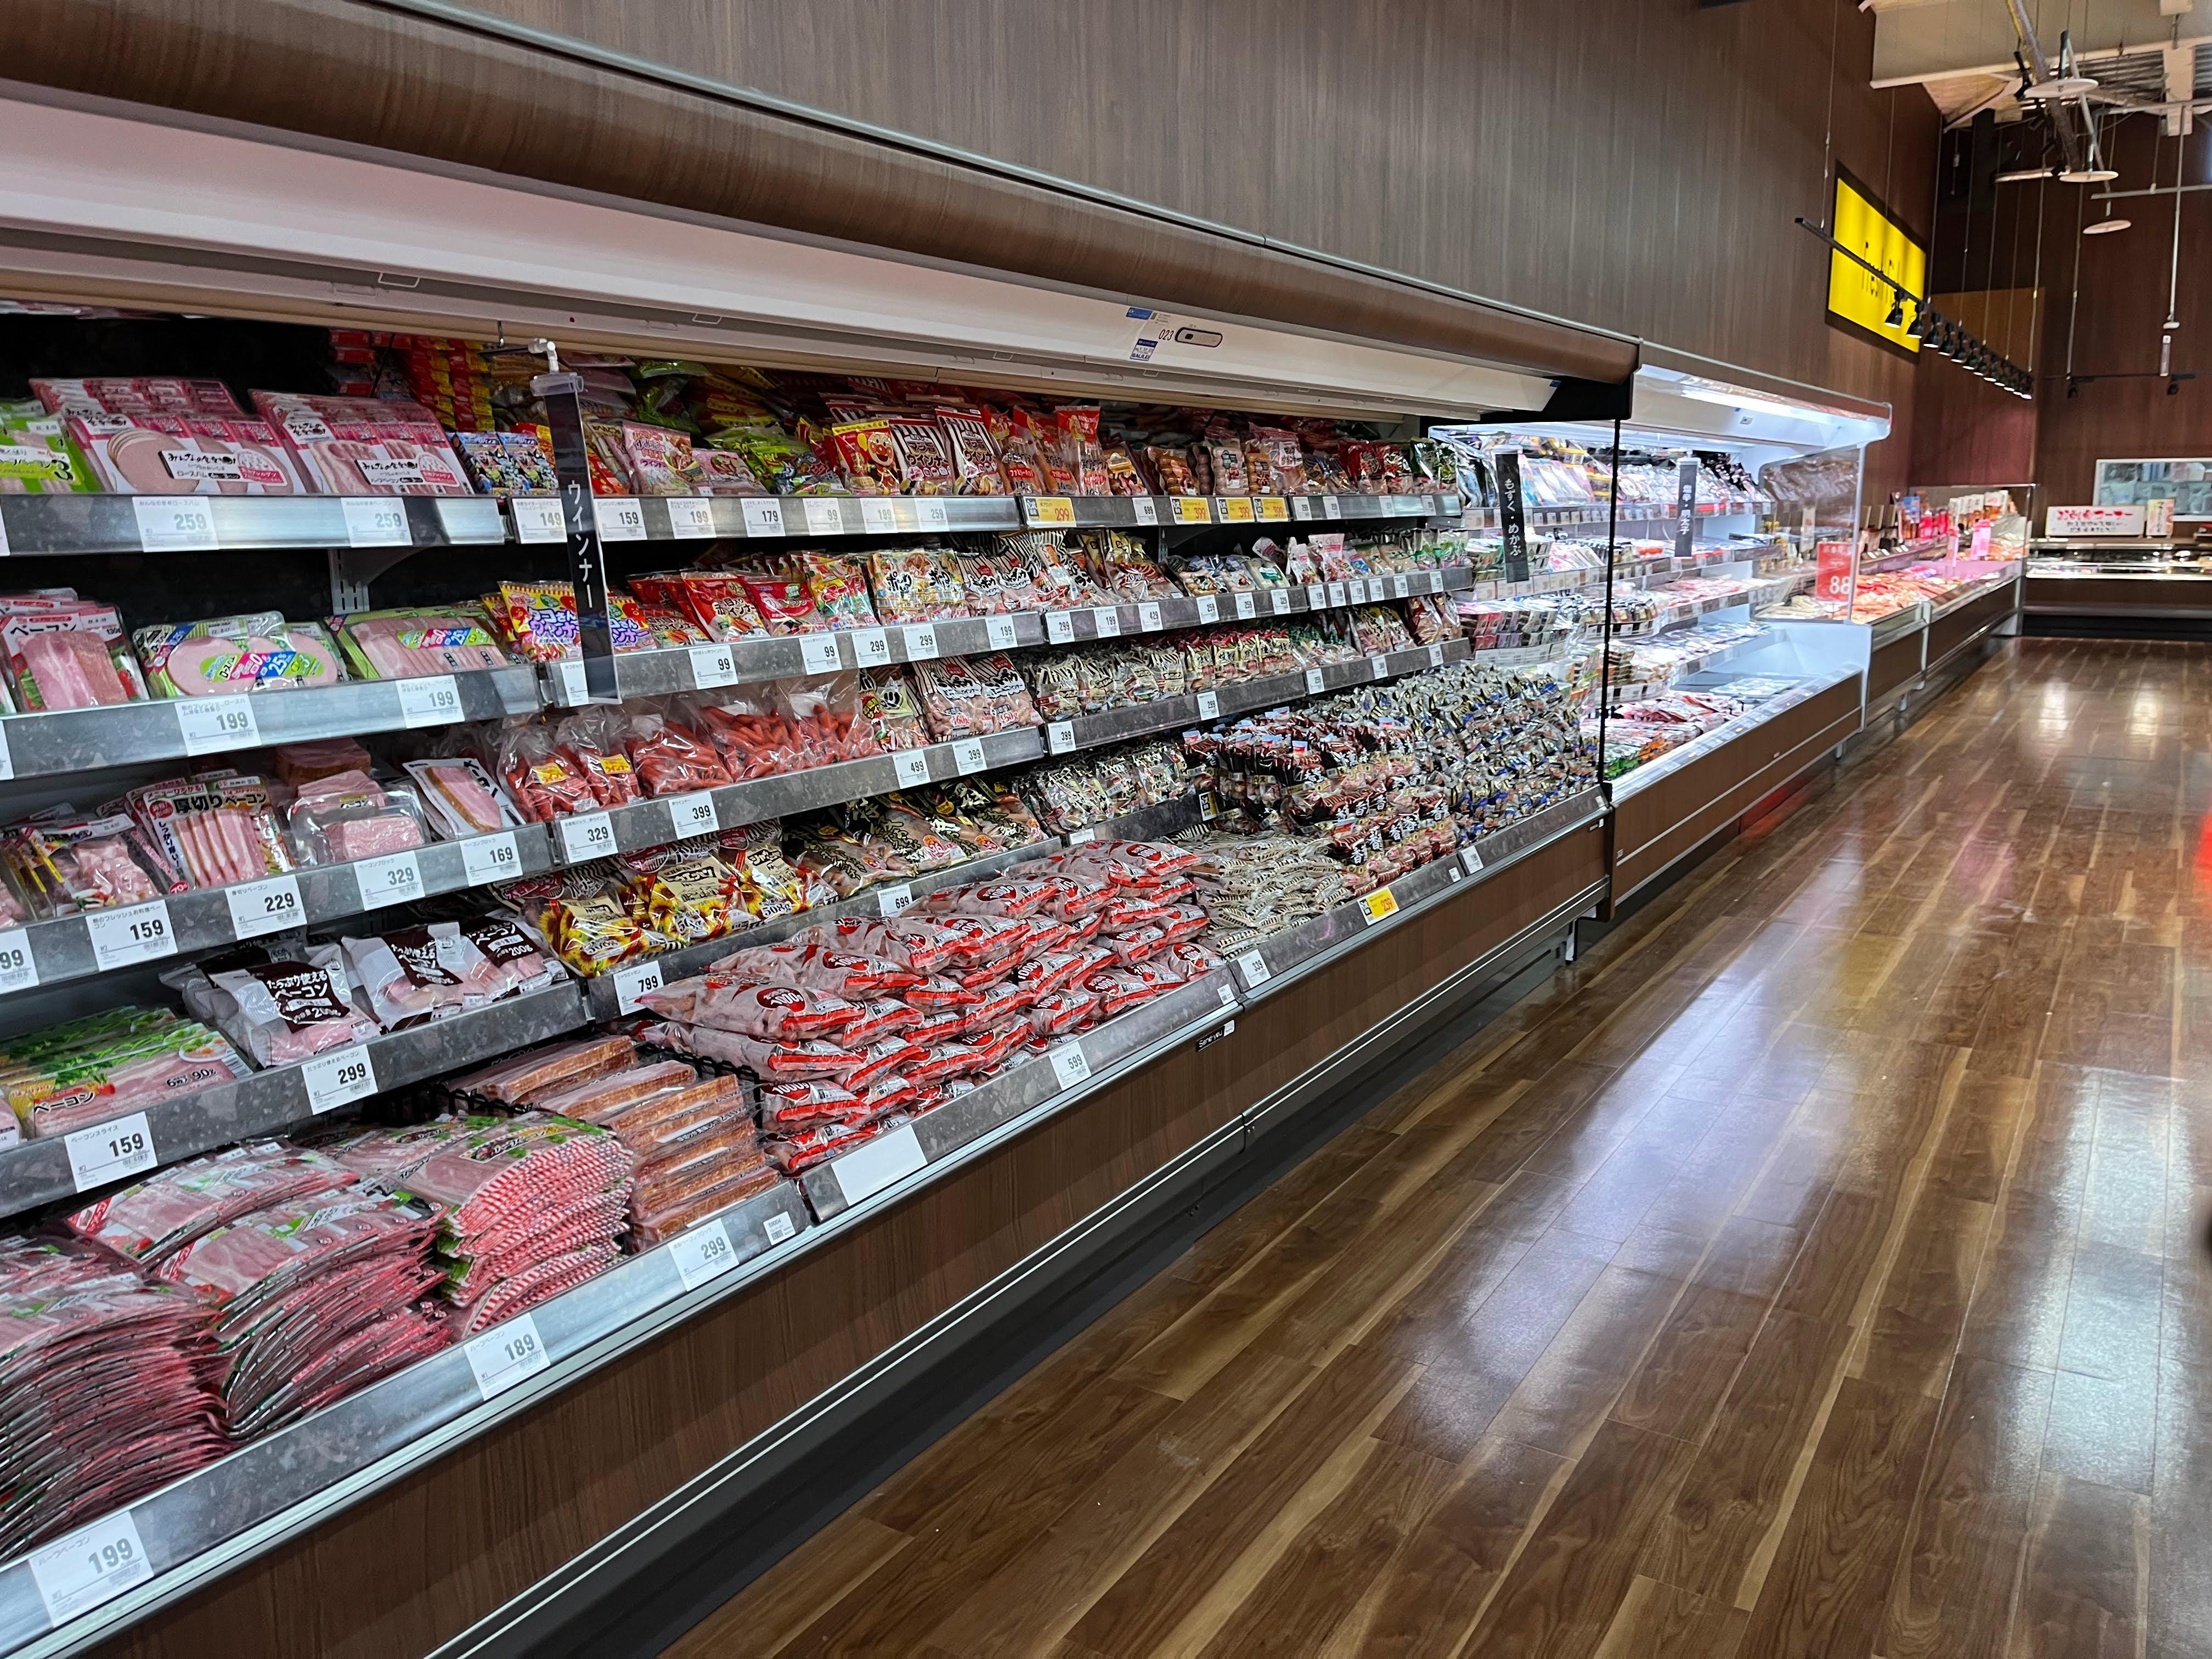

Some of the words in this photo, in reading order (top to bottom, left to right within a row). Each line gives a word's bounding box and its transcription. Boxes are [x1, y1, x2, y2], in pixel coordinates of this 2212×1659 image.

[1158, 329, 1175, 341] 023
[375, 513, 402, 528] 259
[540, 512, 562, 526] 149
[619, 512, 640, 524] 159
[690, 510, 708, 523] 199
[762, 510, 779, 522] 179
[827, 509, 838, 521] 99
[878, 509, 892, 521] 199
[931, 508, 944, 520] 259
[1054, 508, 1069, 521] 299
[1194, 507, 1206, 519] 399
[173, 514, 207, 530] 259
[567, 480, 594, 609] ウインナー
[714, 603, 756, 616] 赤インナー
[1059, 621, 1070, 632] 299
[1105, 616, 1116, 626] 199
[529, 621, 580, 639] ウインナ
[1000, 625, 1013, 637] 199
[870, 640, 885, 652] 299
[919, 635, 933, 646] 299
[824, 646, 836, 658] 99
[718, 657, 731, 671] 99
[428, 691, 454, 707] 199
[216, 711, 249, 731] 199
[1061, 730, 1072, 741] 399
[968, 748, 981, 760] 399
[910, 760, 924, 773] 499
[173, 794, 222, 813] 厚切り
[225, 793, 266, 804] ベーコン
[692, 804, 711, 820] 399
[587, 826, 610, 842] 329
[490, 847, 513, 864] 169
[358, 858, 395, 869] ベーコンブロック
[387, 867, 414, 885] 329
[264, 891, 295, 912] 229
[895, 896, 909, 909] 699
[761, 902, 792, 918] 508g
[129, 919, 165, 940] 159
[476, 924, 516, 945] ベーコン
[509, 944, 533, 957] 200g
[1018, 960, 1041, 980] 1000g
[275, 983, 329, 998] ベーコン
[637, 975, 659, 993] 799
[771, 991, 803, 1006] 1000g
[1067, 1053, 1084, 1070] 599
[337, 1063, 366, 1085] 299
[772, 1082, 810, 1096] 1000g
[34, 1092, 95, 1113] ベーコン
[70, 1125, 119, 1143] ベーコンスライス
[109, 1132, 145, 1158] 159
[701, 1236, 726, 1260] 299
[504, 1334, 535, 1361] 189
[88, 1537, 134, 1575] 199
